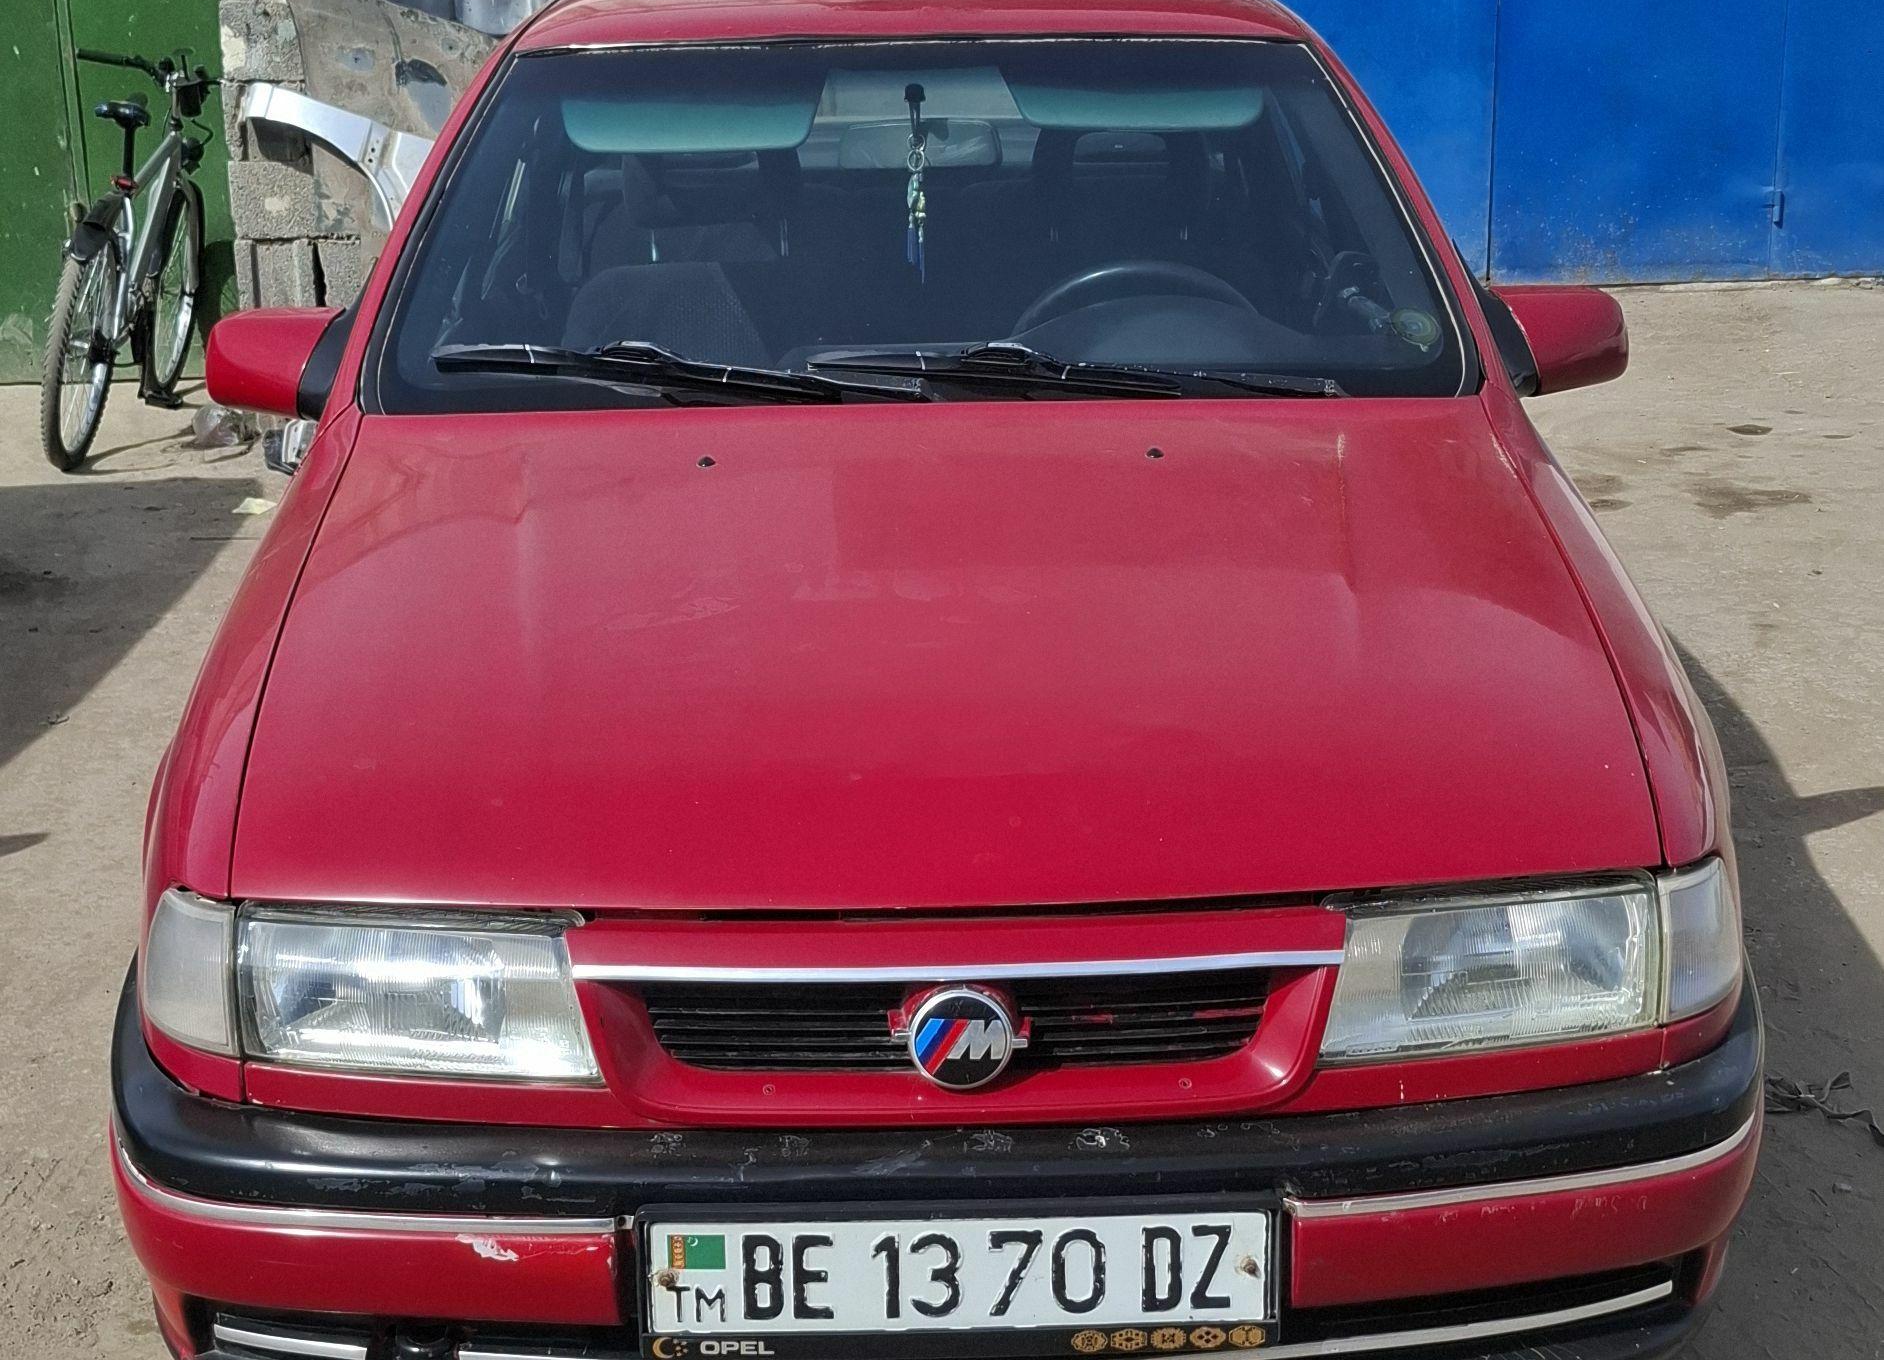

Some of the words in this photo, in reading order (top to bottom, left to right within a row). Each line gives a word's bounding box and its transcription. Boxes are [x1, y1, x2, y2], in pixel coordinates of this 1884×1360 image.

[742, 1233, 834, 1320] BE
[1141, 1224, 1232, 1312] DZ
[666, 1285, 726, 1322] TM
[700, 1340, 775, 1355] OPEL
